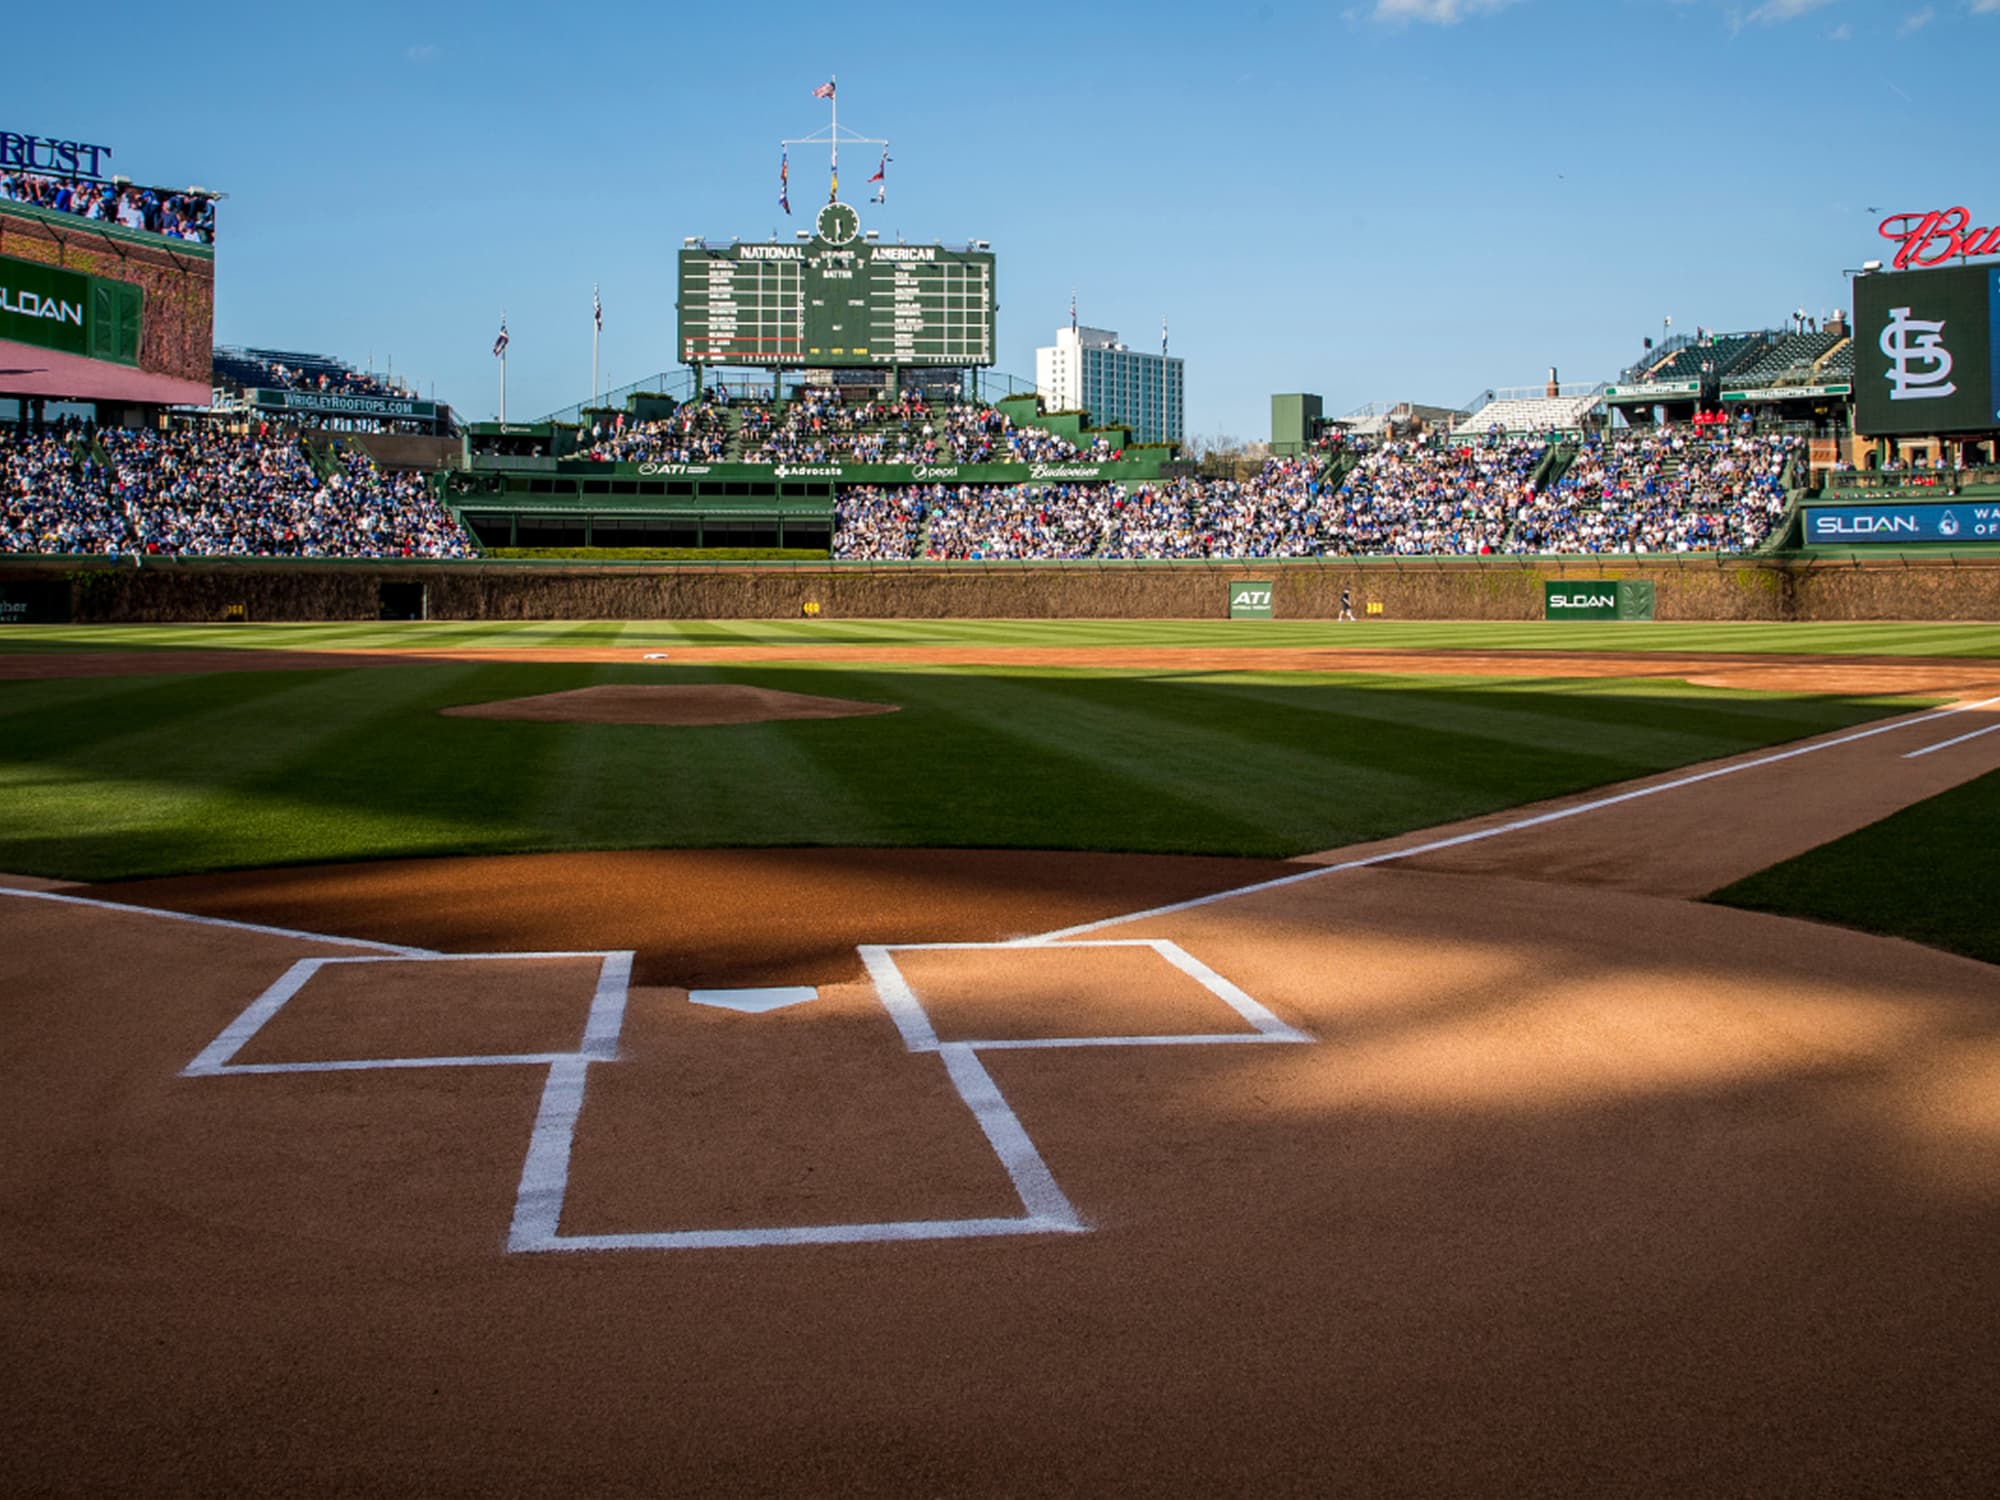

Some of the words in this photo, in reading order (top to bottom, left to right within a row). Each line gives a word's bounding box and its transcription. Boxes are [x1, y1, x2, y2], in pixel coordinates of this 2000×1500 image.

[740, 247, 805, 259] NATIONAL
[871, 248, 935, 260] AMERICAN
[0, 287, 82, 326] LOAN
[283, 392, 413, 414] WRIGLEYROOFTOPS.COM
[657, 464, 686, 475] ATI
[790, 466, 843, 476] Advocate
[928, 466, 958, 478] pepsi
[1028, 464, 1100, 479] Budweiser
[1974, 524, 1998, 535] OF
[1232, 591, 1271, 604] ATI
[1550, 594, 1614, 608] SLOAN
